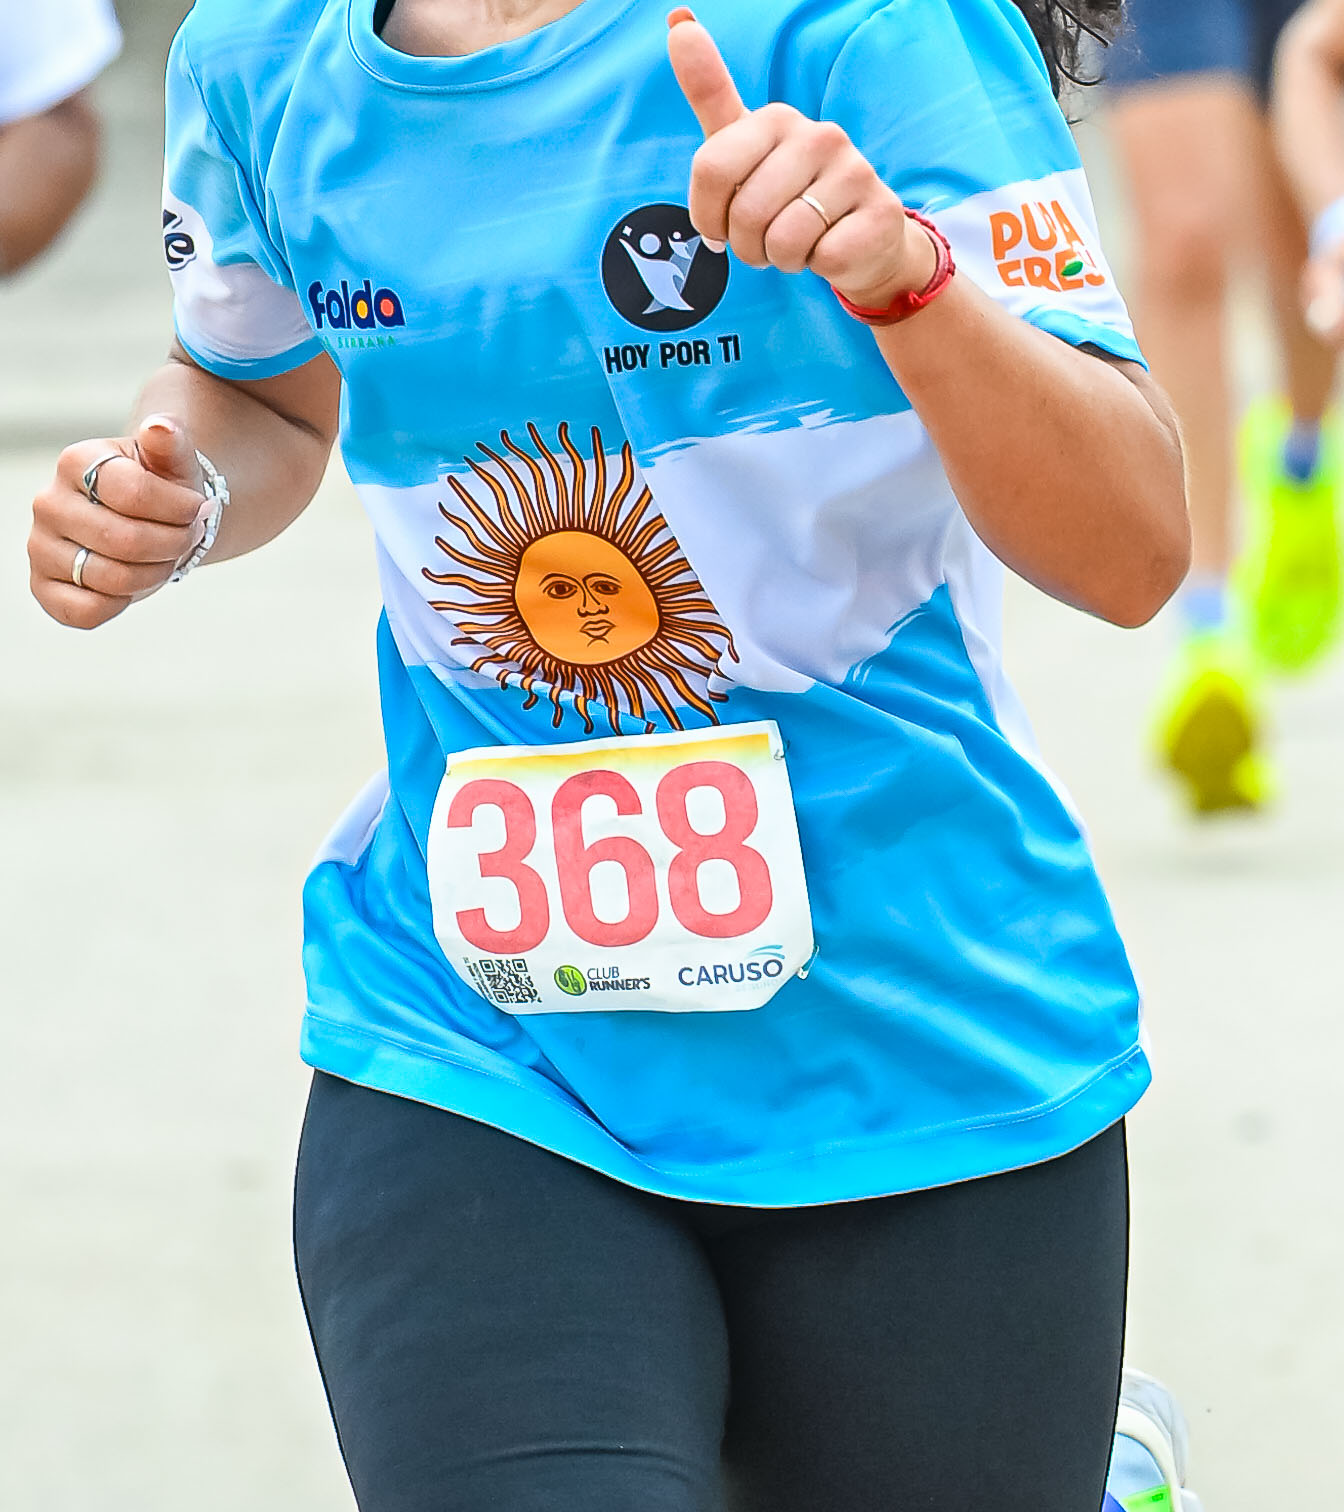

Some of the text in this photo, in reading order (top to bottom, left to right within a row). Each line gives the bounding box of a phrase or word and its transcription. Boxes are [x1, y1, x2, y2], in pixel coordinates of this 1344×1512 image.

[604, 334, 741, 374] HOY POR TI
[446, 759, 774, 955] 368
[586, 965, 620, 980] CLUB
[587, 976, 651, 991] RUNNER'S
[677, 958, 784, 987] CARUSO
